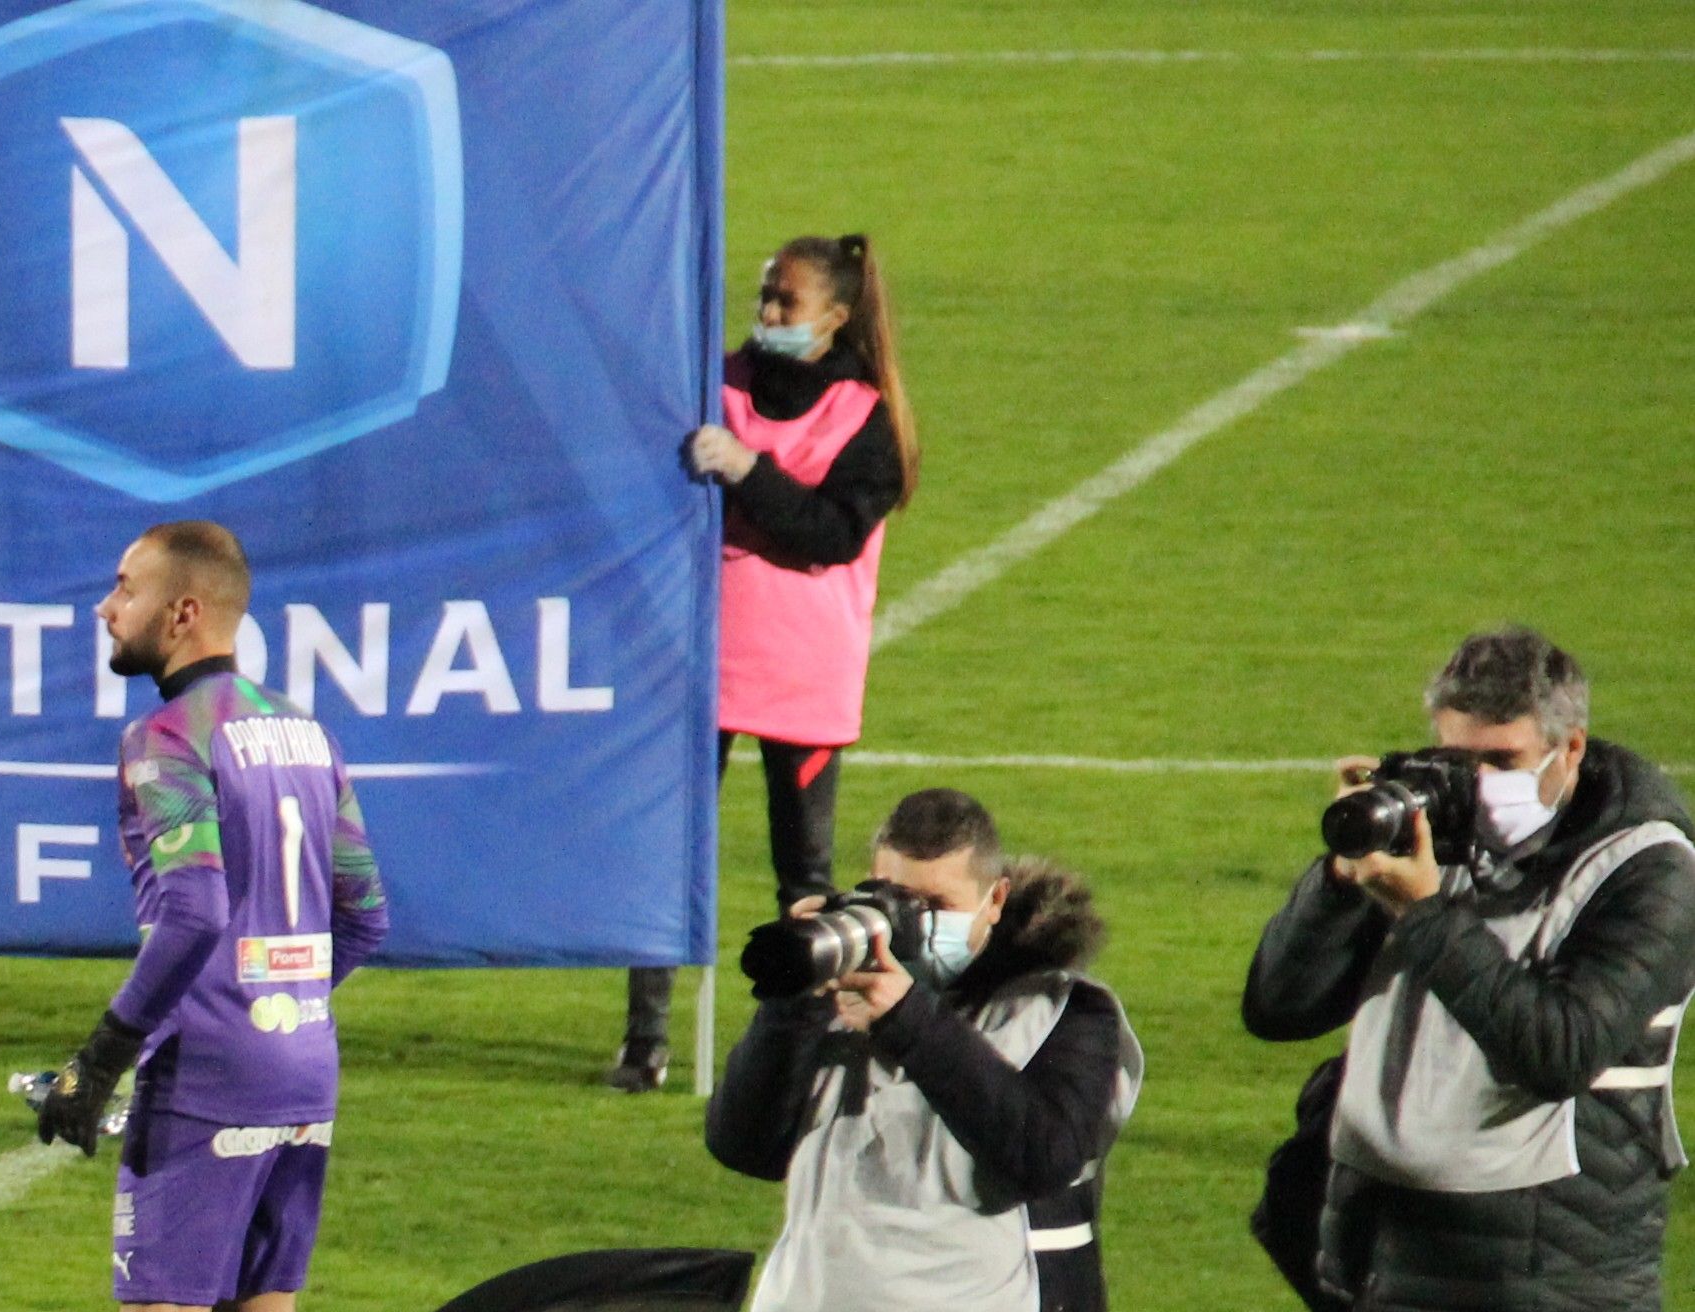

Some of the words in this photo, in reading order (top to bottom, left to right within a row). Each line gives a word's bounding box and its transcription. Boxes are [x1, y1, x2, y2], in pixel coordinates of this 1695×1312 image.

[60, 115, 297, 370] N
[16, 822, 99, 904] F
[279, 795, 305, 928] 1
